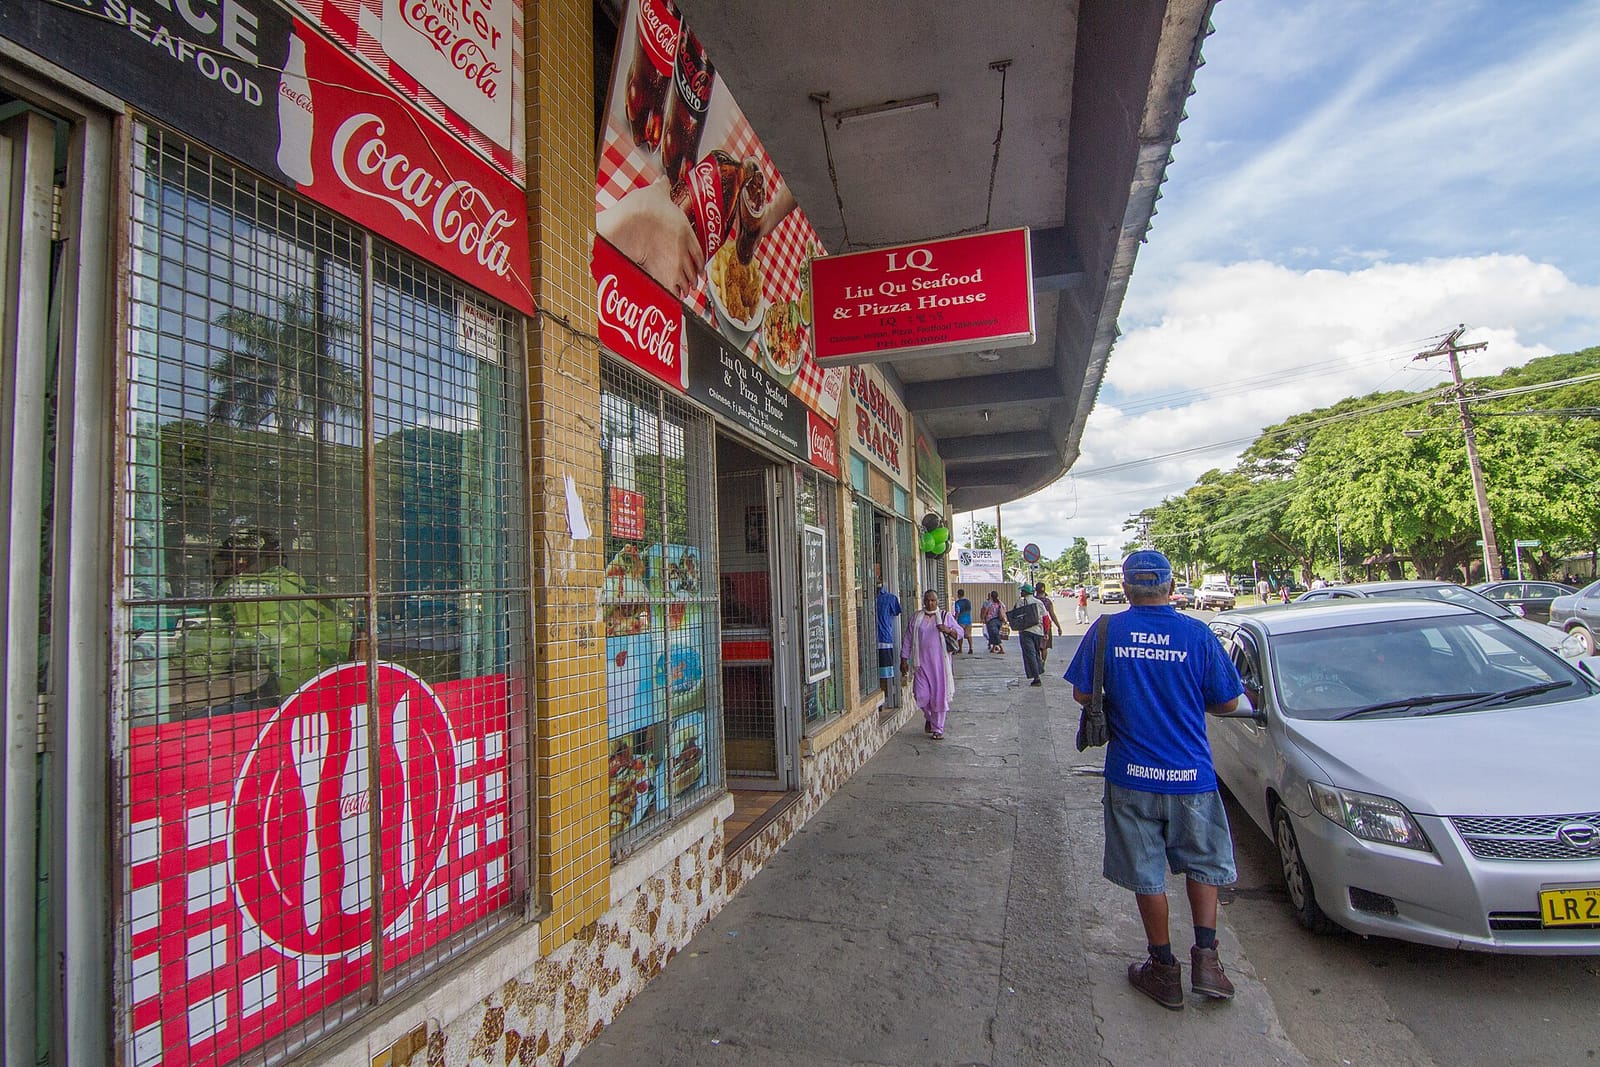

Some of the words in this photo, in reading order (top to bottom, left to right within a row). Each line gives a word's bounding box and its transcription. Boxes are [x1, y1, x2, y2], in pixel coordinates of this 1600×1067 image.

[431, 0, 459, 31] with
[103, 0, 262, 107] SEAFOOD
[681, 74, 701, 110] zero
[331, 112, 517, 277] Coca-Cola
[886, 249, 938, 273] LQ
[844, 286, 874, 300] Liu
[879, 281, 906, 296] Qu
[911, 268, 983, 291] Seafood
[597, 274, 678, 367] Coca-Cola
[832, 307, 852, 320] &
[858, 301, 912, 317] Pizza
[918, 292, 987, 310] House
[720, 347, 733, 370] Liu
[734, 358, 747, 380] Qu
[751, 367, 763, 386] LQ
[765, 381, 788, 408] Seafood
[724, 370, 732, 387] &
[740, 380, 758, 405] Pizza
[764, 397, 784, 421] House
[849, 366, 904, 447] FASHION
[856, 403, 901, 476] RACK
[972, 550, 992, 559] SUPER
[1114, 646, 1188, 663] INTEGRITY
[1131, 632, 1170, 646] TEAM
[1126, 763, 1165, 781] SHERATON
[1166, 769, 1198, 782] SECURITY
